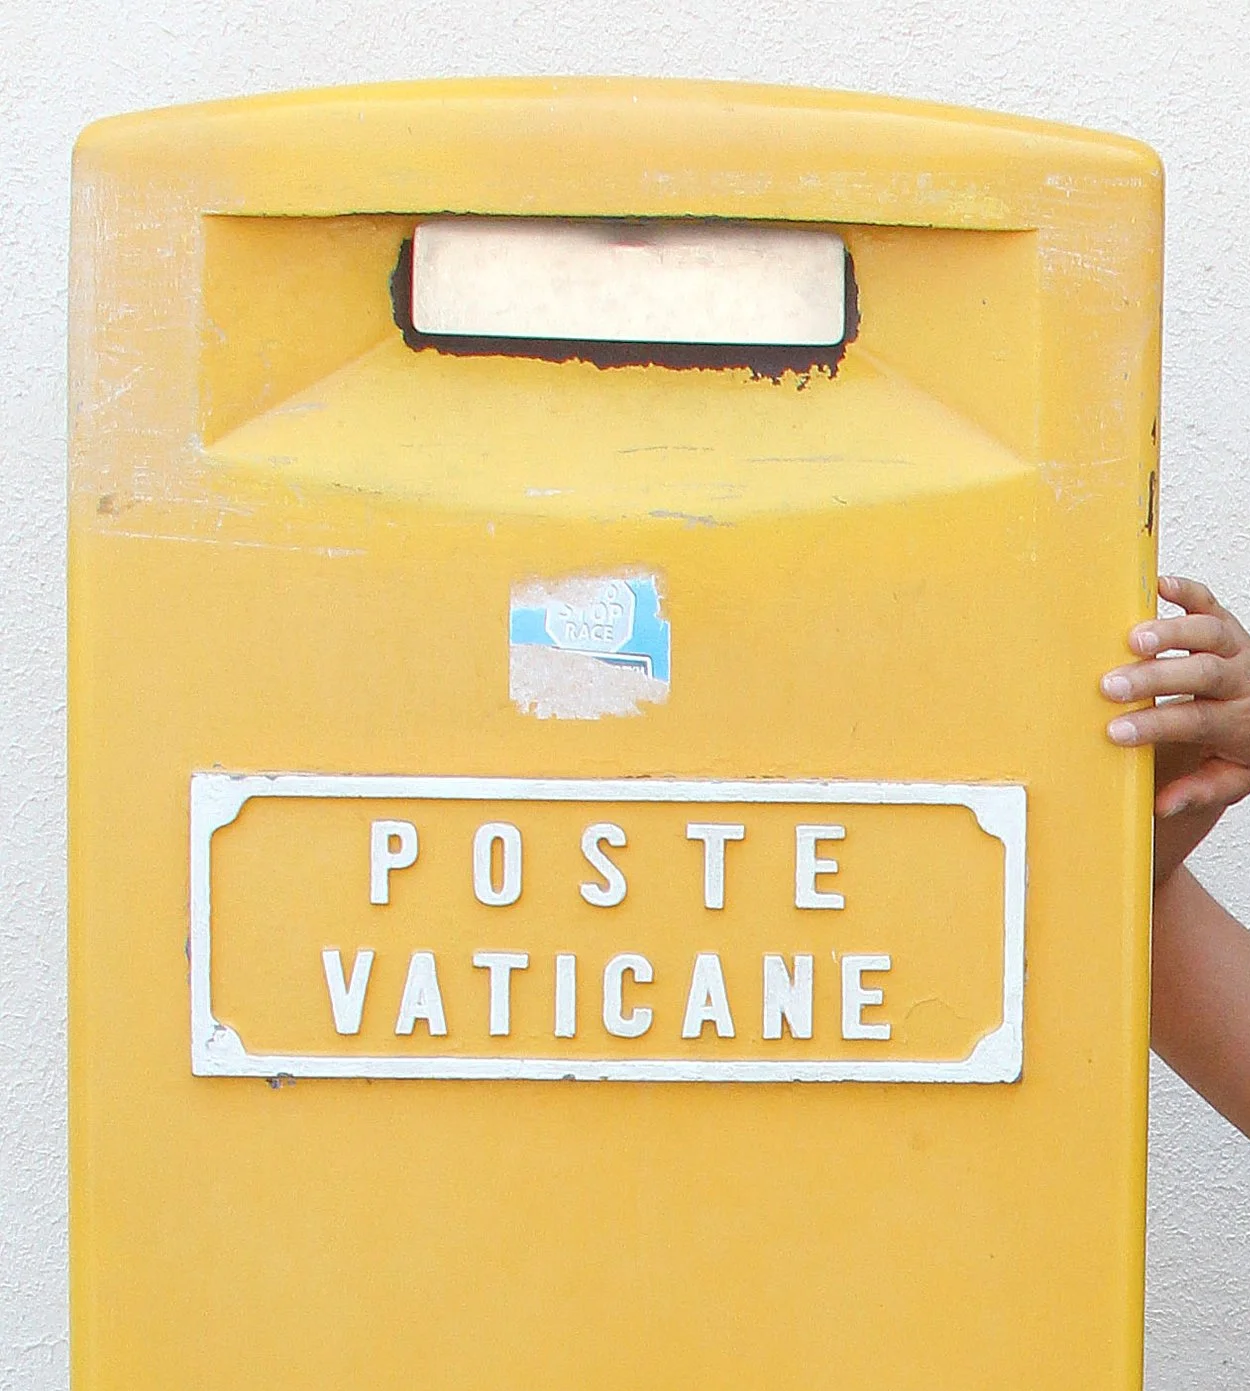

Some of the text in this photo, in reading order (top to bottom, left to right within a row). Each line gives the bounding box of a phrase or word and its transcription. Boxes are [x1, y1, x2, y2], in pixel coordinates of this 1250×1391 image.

[564, 622, 616, 642] RACE
[369, 819, 846, 909] POSTE
[321, 948, 892, 1040] VATICANE
